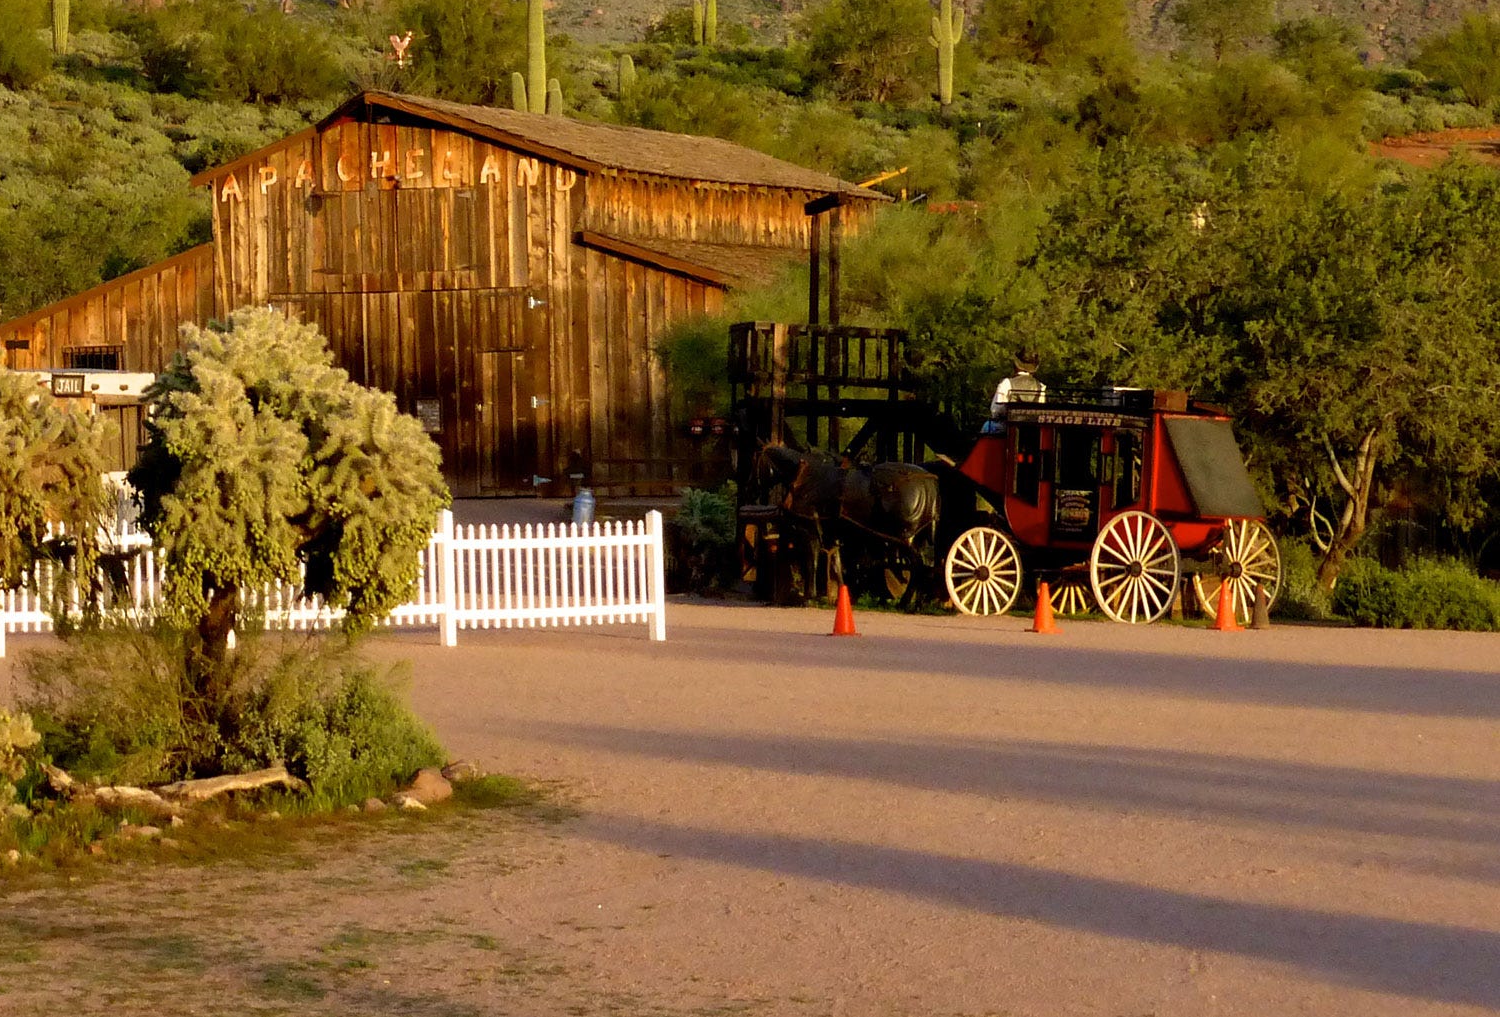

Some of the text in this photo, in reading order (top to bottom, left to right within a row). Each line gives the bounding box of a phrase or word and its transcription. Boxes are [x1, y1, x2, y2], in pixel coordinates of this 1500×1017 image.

[220, 148, 577, 203] APACHELAND
[55, 378, 81, 394] JAIL
[1037, 415, 1083, 425] STAGE
[1086, 417, 1122, 427] LINE
